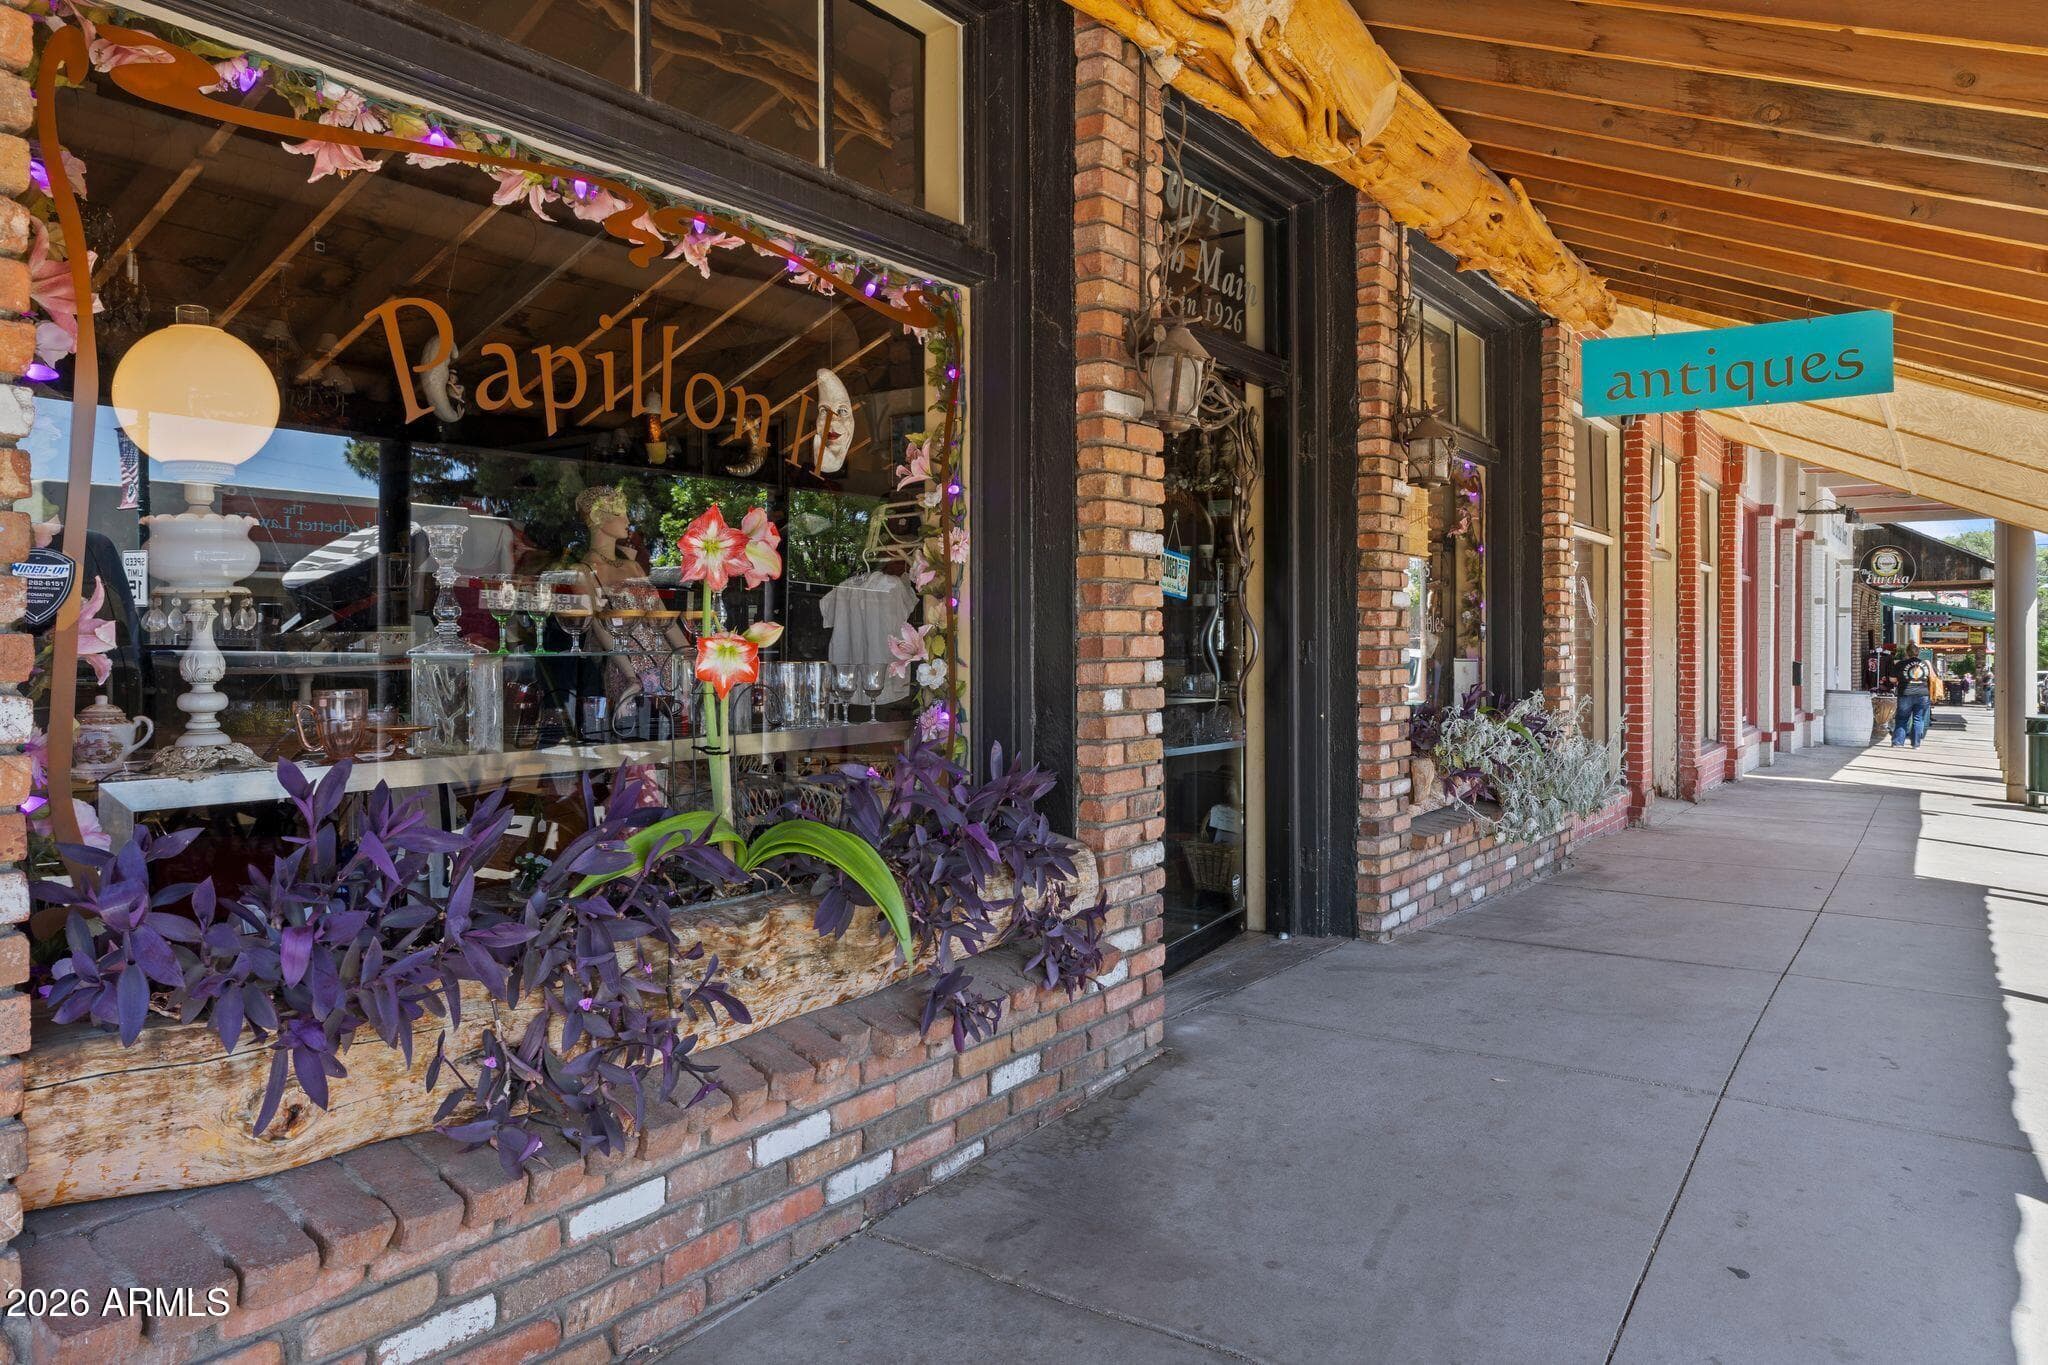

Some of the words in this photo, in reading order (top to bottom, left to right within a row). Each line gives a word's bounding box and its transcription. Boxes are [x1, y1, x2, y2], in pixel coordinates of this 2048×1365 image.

[1192, 238, 1257, 307] Main
[1205, 298, 1244, 334] 1926
[364, 297, 771, 448] Papillon
[1606, 347, 1865, 402] antiques
[1866, 573, 1910, 585] Eureka
